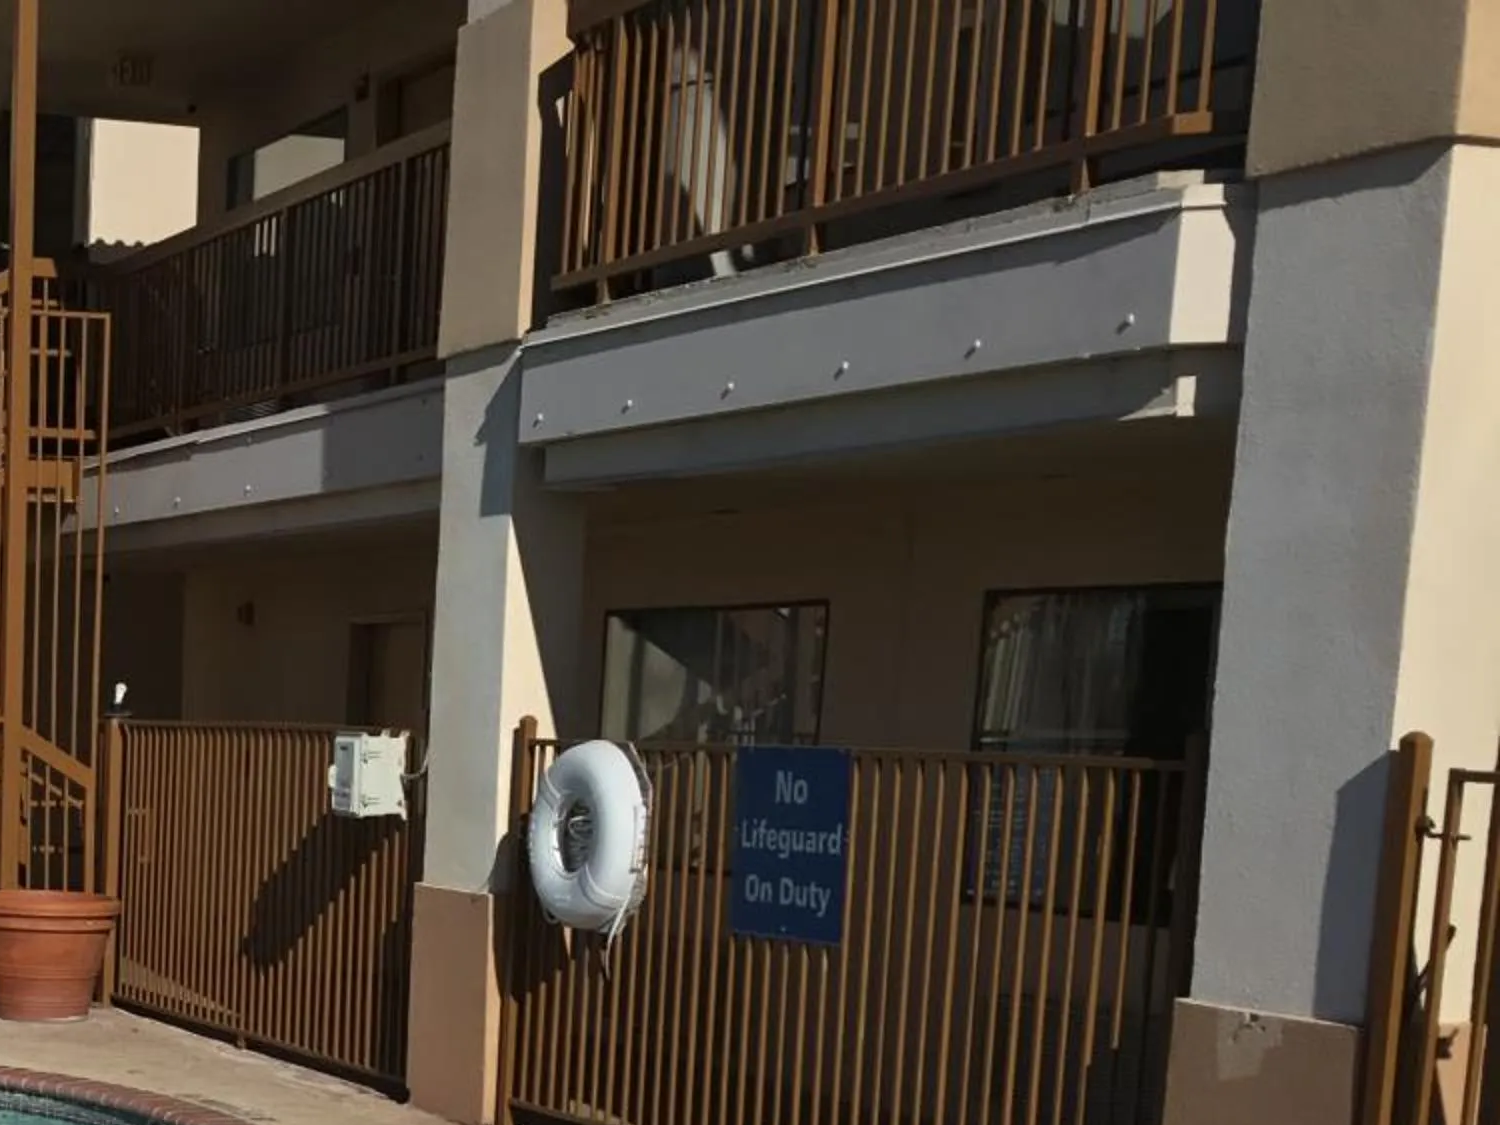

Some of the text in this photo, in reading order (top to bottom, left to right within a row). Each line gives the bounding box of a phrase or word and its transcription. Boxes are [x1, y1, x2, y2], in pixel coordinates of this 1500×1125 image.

[775, 770, 808, 805] No
[740, 819, 842, 859] Lifeguard
[745, 874, 831, 917] On Duty
